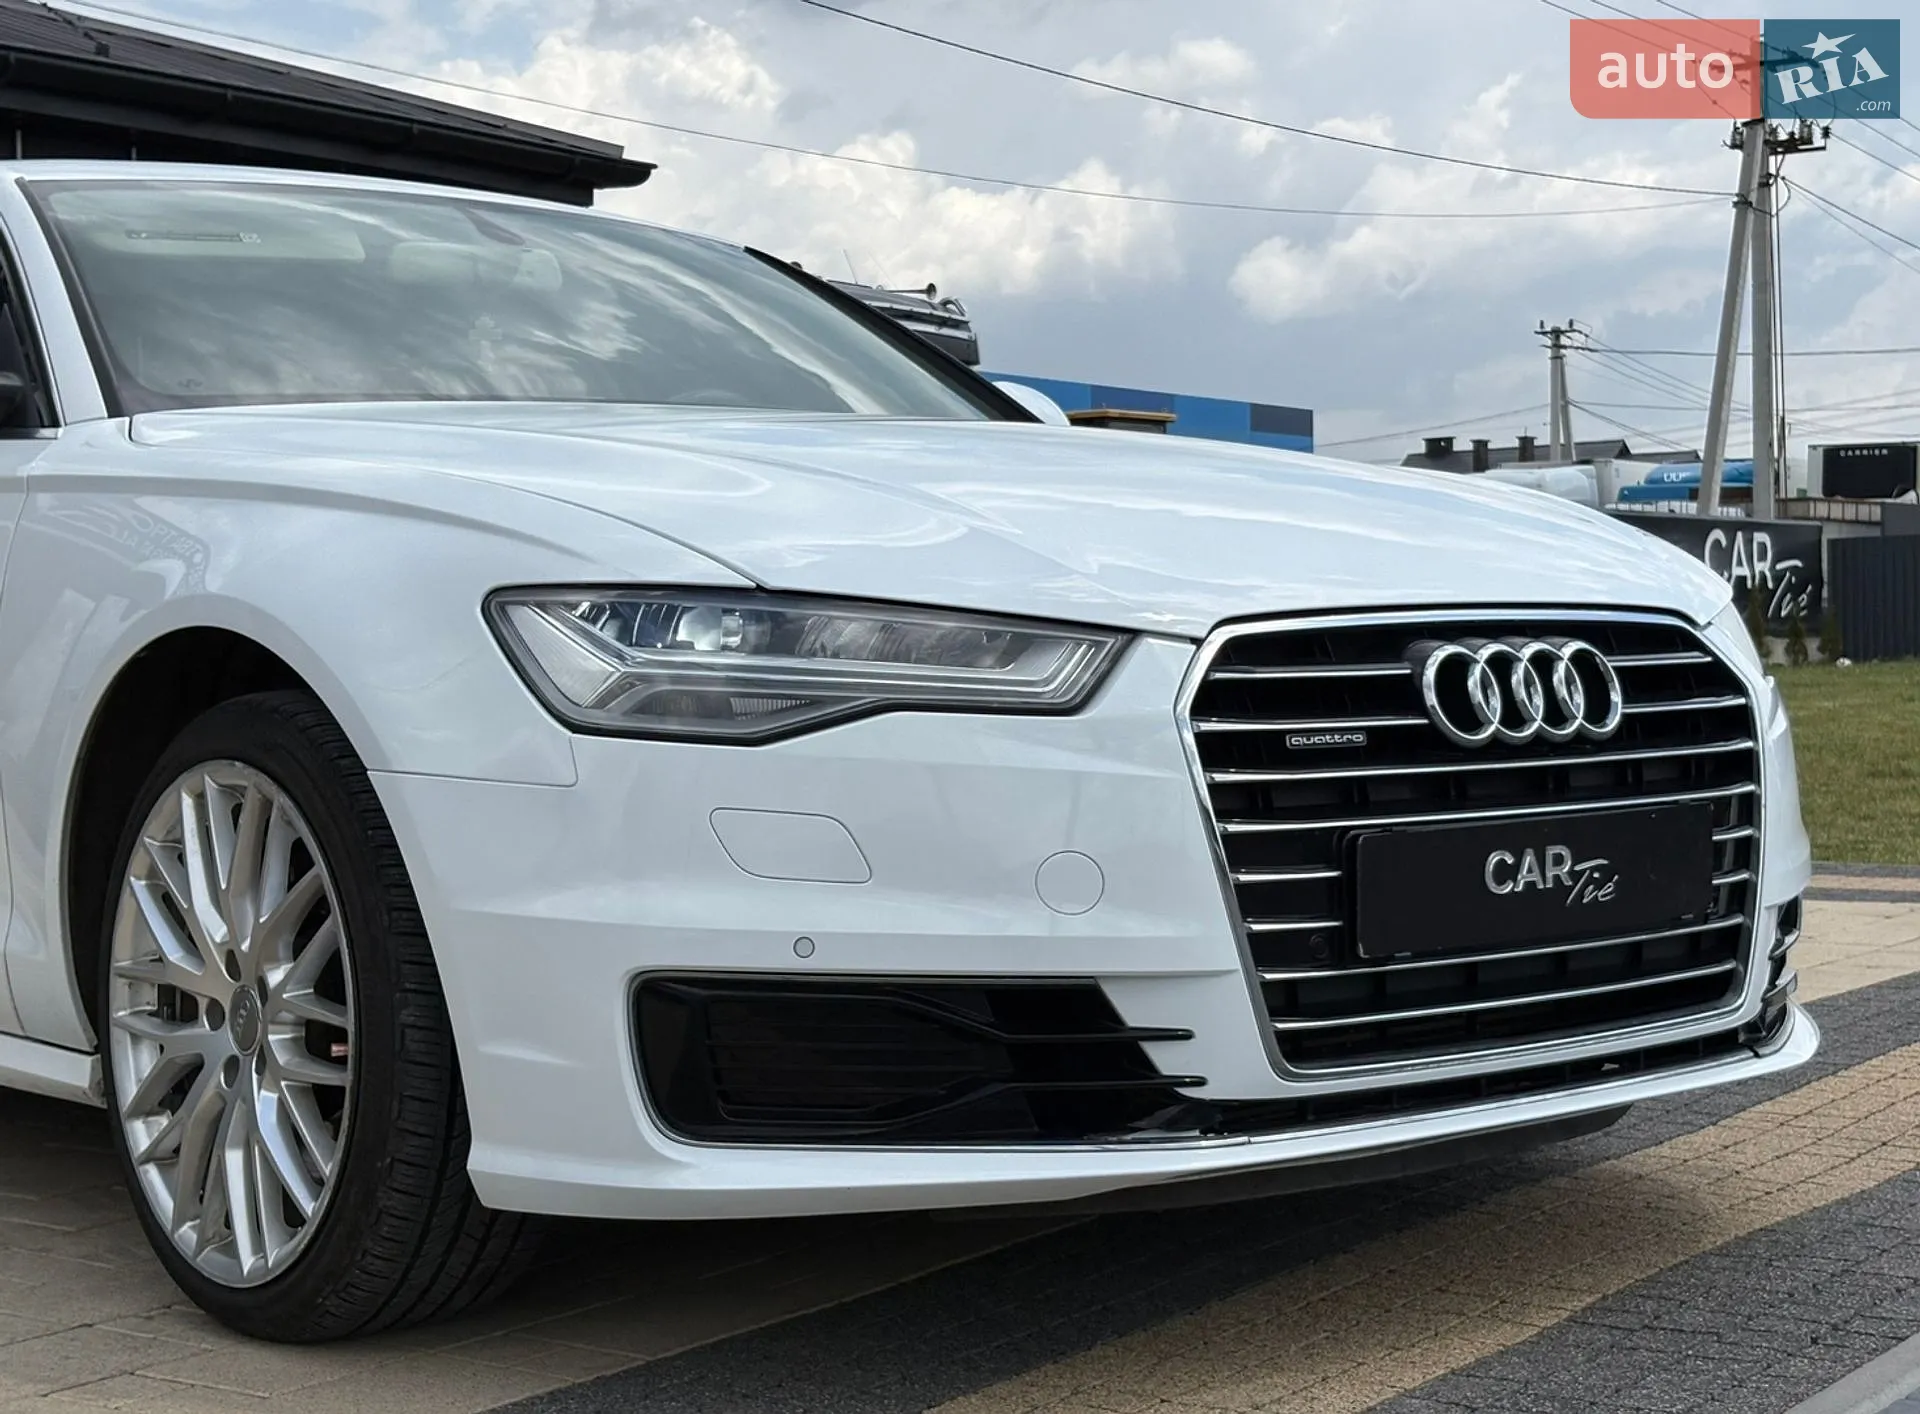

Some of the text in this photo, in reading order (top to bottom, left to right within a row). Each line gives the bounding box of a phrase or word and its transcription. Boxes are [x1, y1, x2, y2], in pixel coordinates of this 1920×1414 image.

[1704, 528, 1773, 589] CAR
[1291, 734, 1363, 746] quattro
[1485, 845, 1572, 894] CAR
